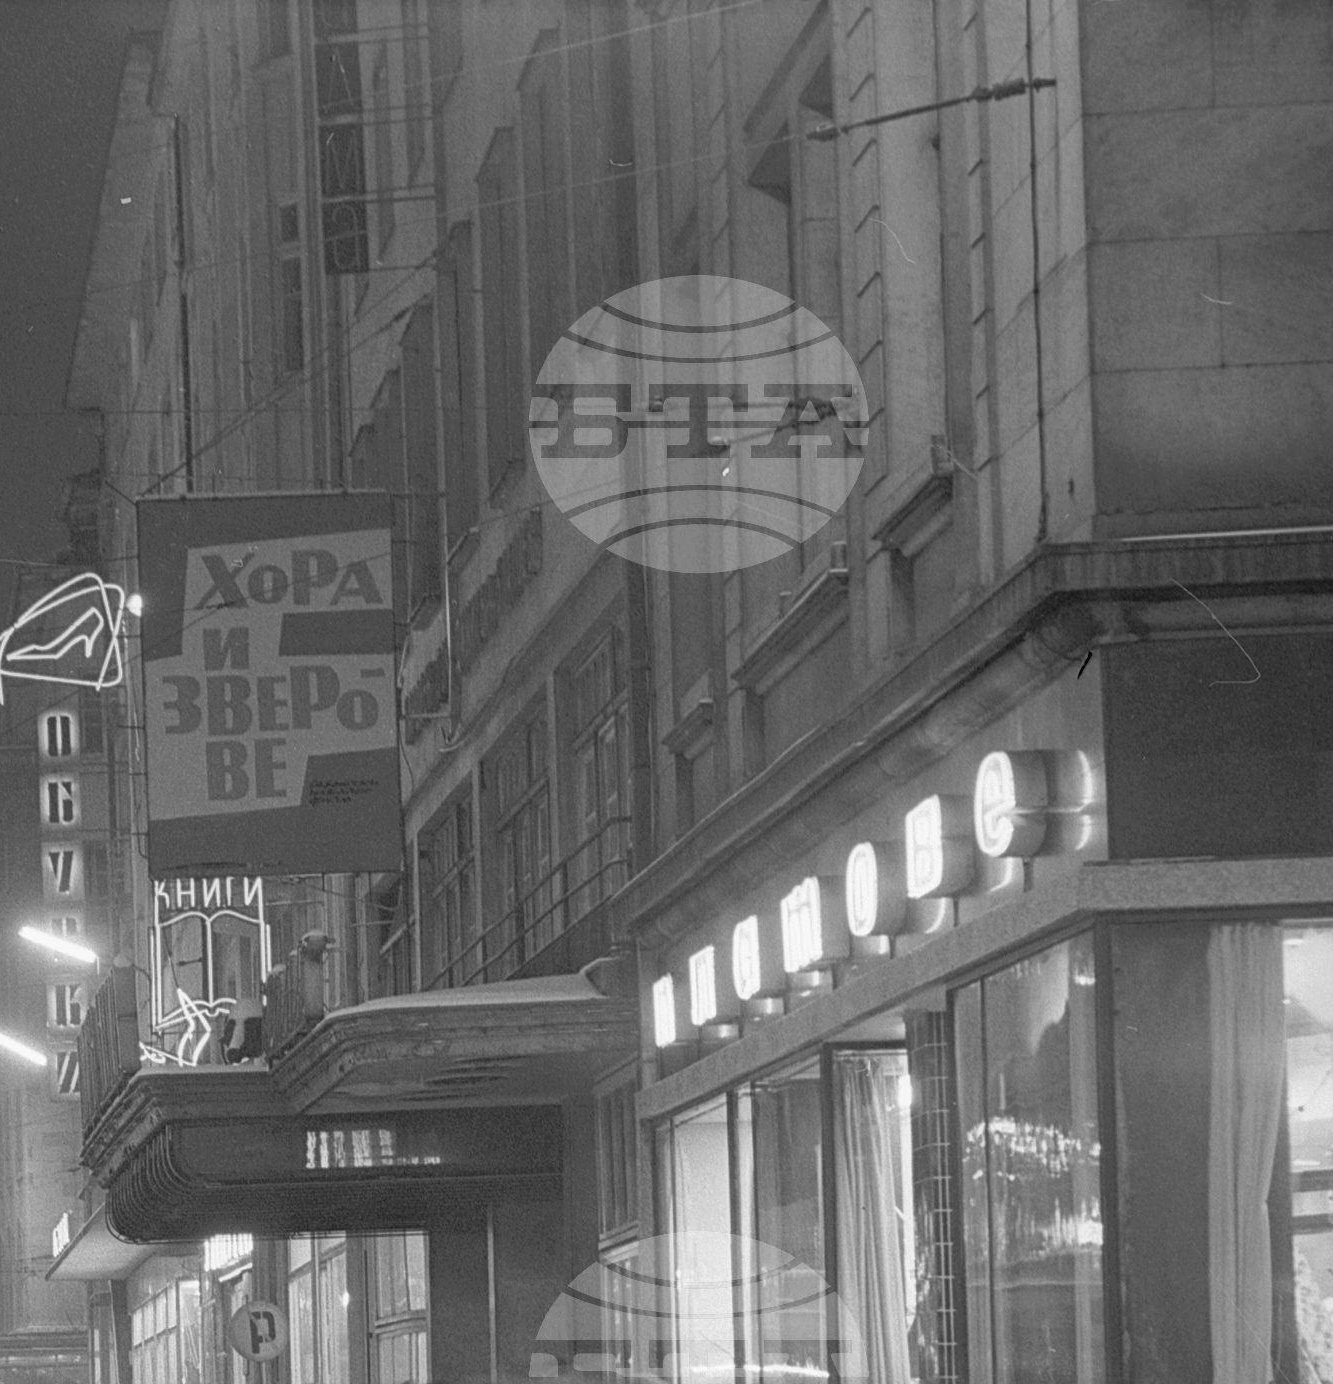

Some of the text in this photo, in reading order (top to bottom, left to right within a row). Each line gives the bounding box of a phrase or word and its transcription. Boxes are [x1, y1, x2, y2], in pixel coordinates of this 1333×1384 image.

[203, 627, 249, 670] И
[206, 738, 287, 801] ВЕ
[154, 877, 262, 908] КНИГИ
[249, 1310, 276, 1354] P
